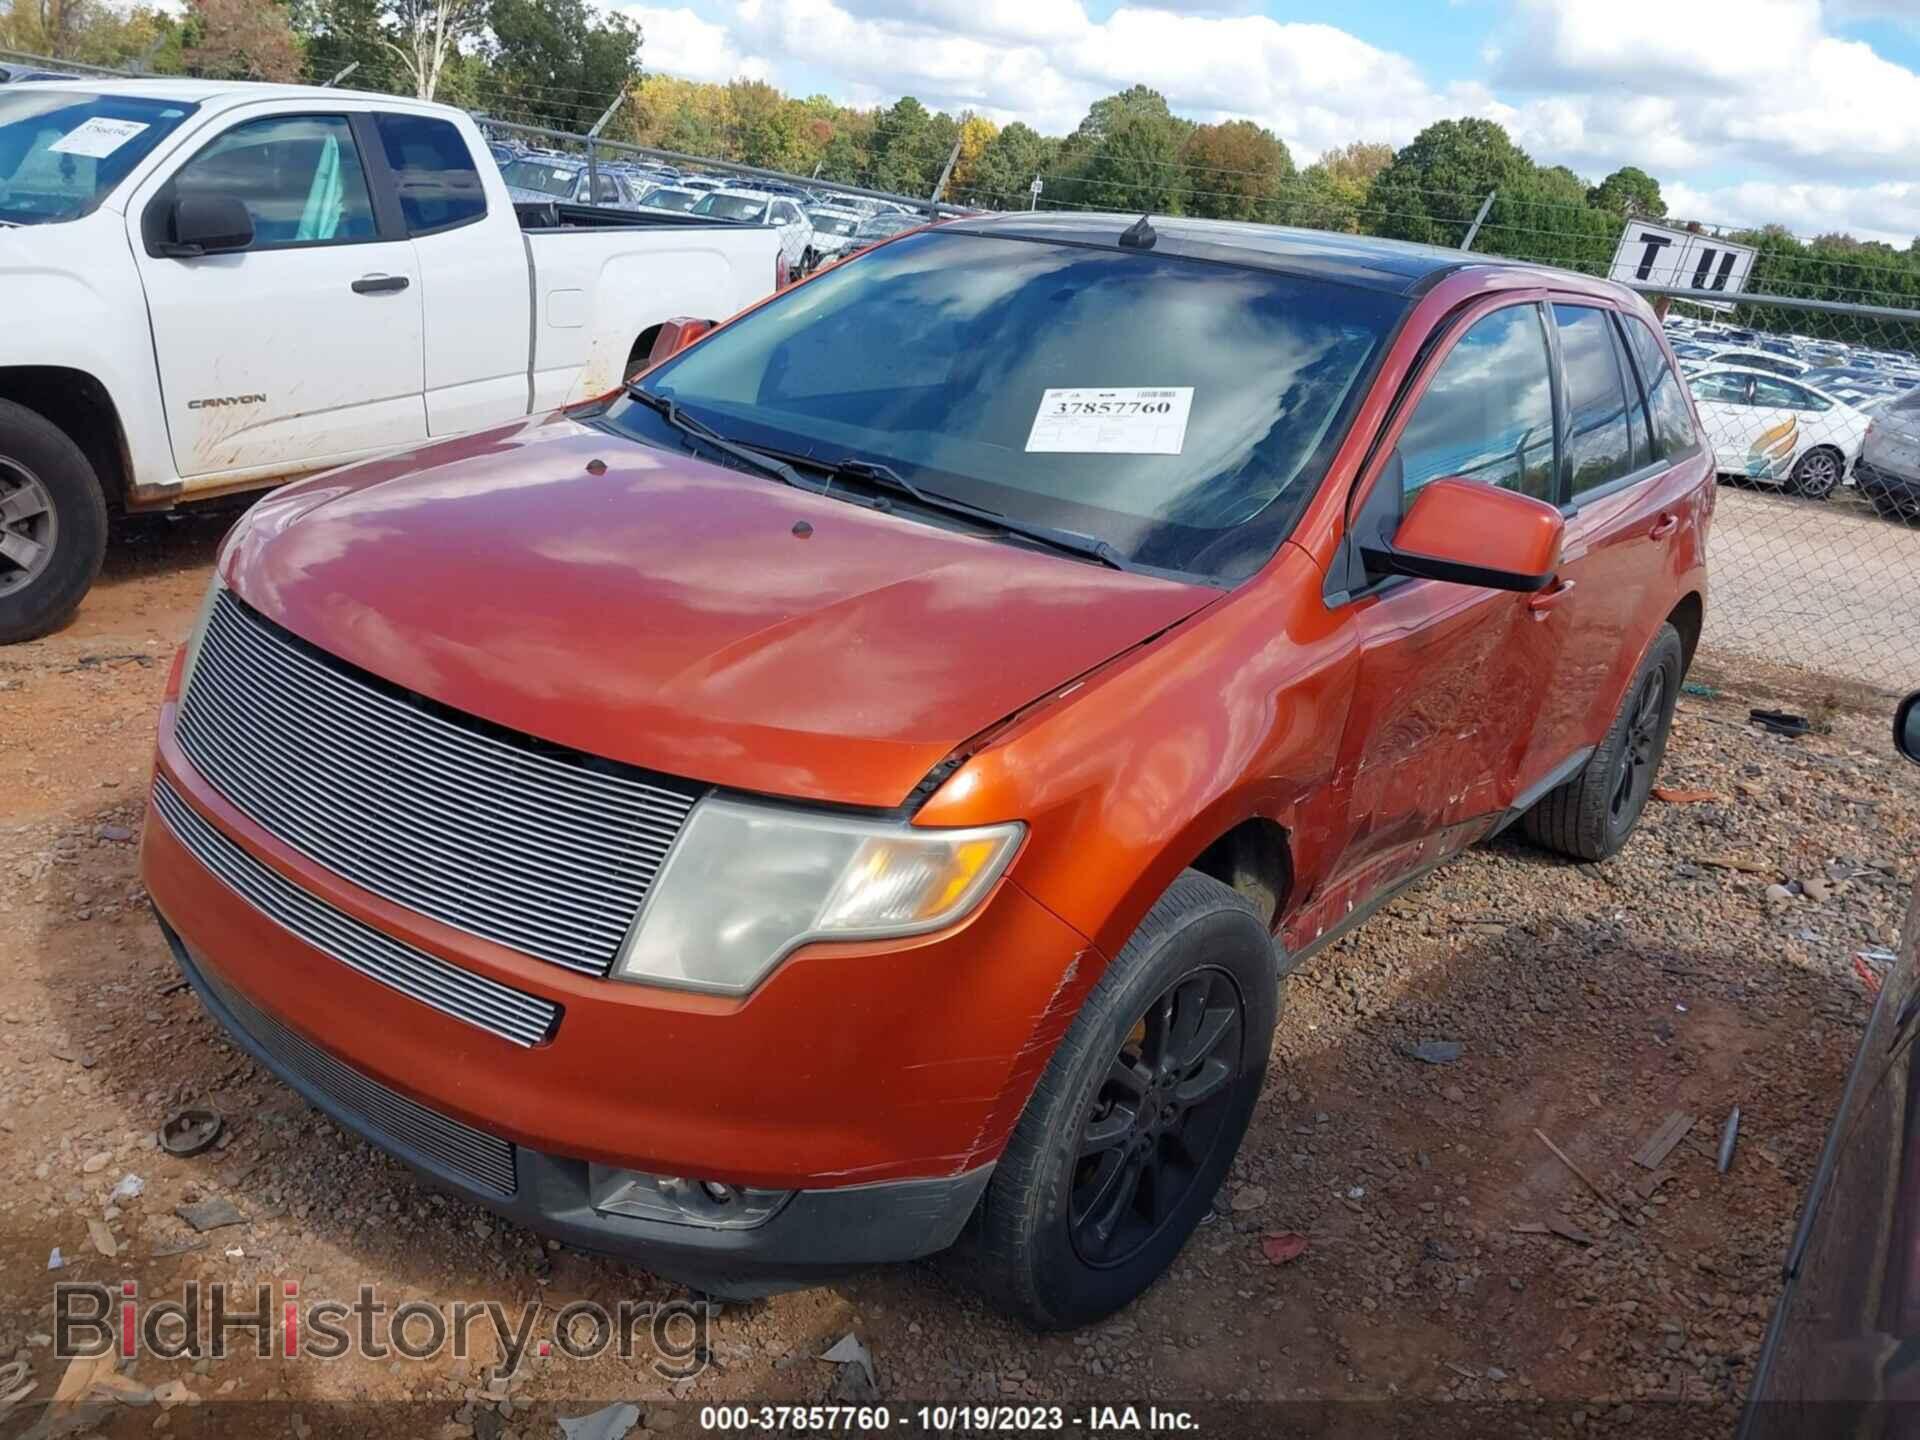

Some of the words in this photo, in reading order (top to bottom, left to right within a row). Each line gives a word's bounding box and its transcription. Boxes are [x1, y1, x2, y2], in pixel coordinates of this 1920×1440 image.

[1636, 233, 1672, 280] T
[187, 393, 267, 410] CANYON
[1053, 402, 1171, 414] 37857760
